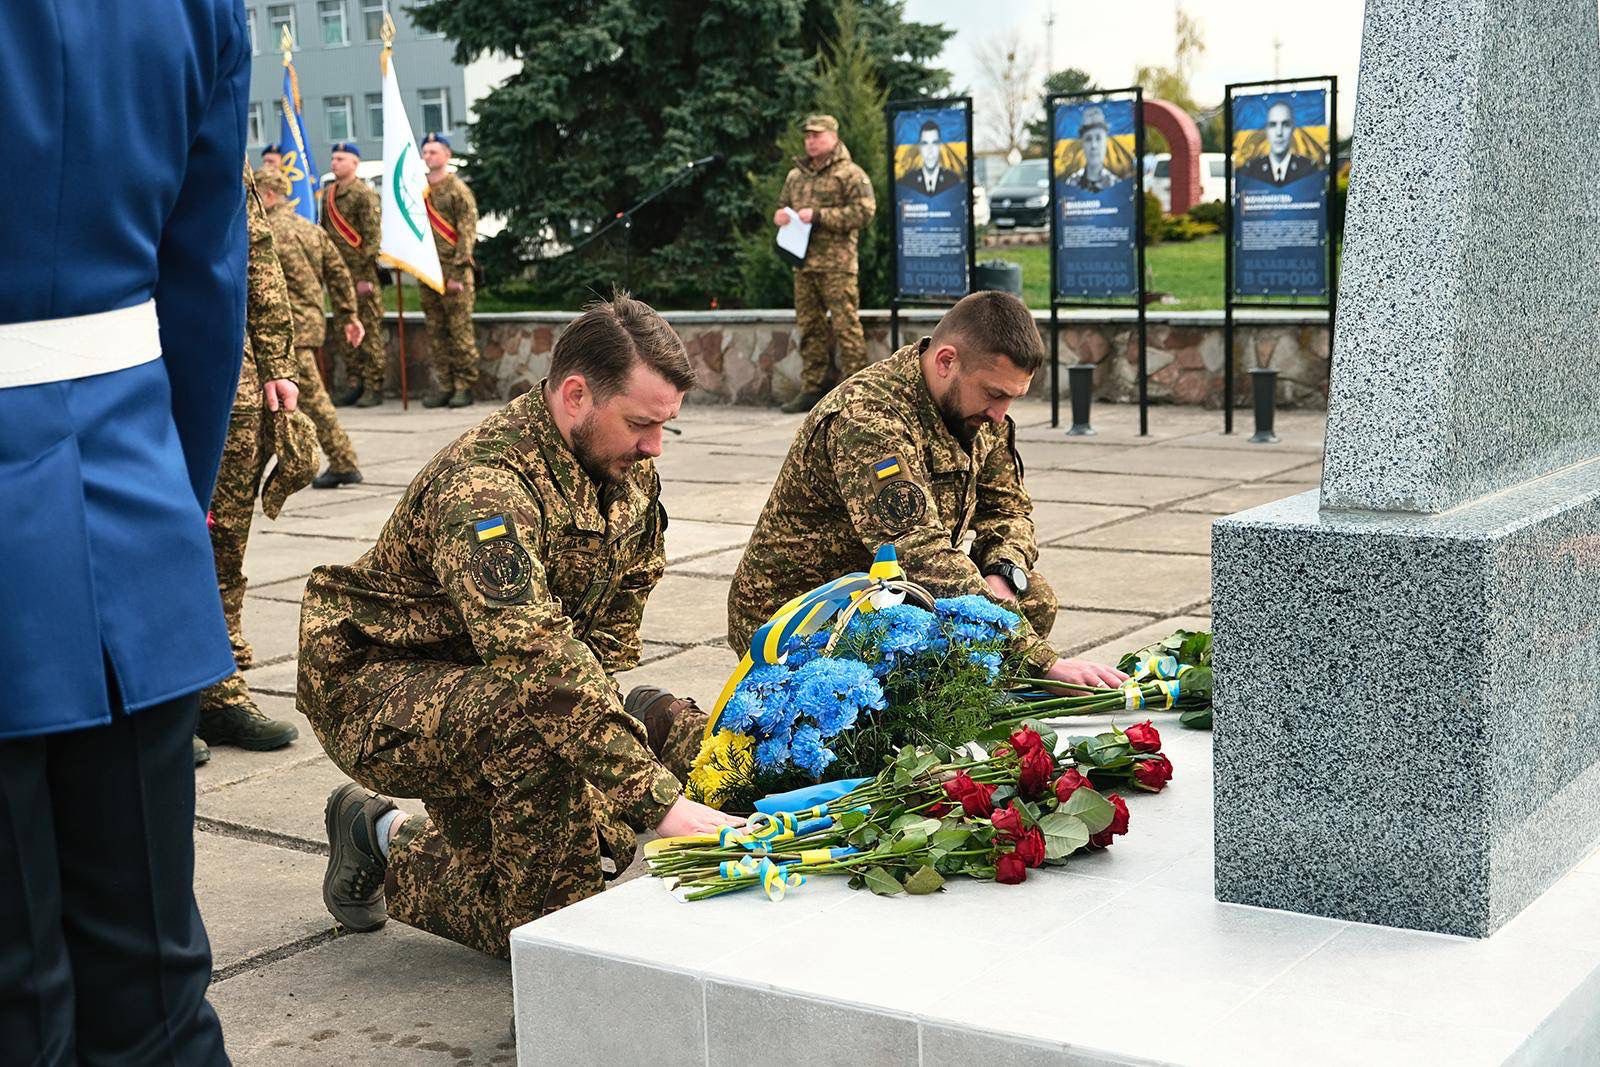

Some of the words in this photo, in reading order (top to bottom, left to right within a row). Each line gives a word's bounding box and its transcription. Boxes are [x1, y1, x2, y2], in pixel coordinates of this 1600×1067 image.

[904, 273, 913, 286] В
[915, 273, 961, 286] СТРОЮ
[1066, 274, 1075, 287] В
[1078, 273, 1129, 287] СТРОЮ
[1243, 271, 1254, 286] В
[1257, 271, 1318, 286] СТРОЮ
